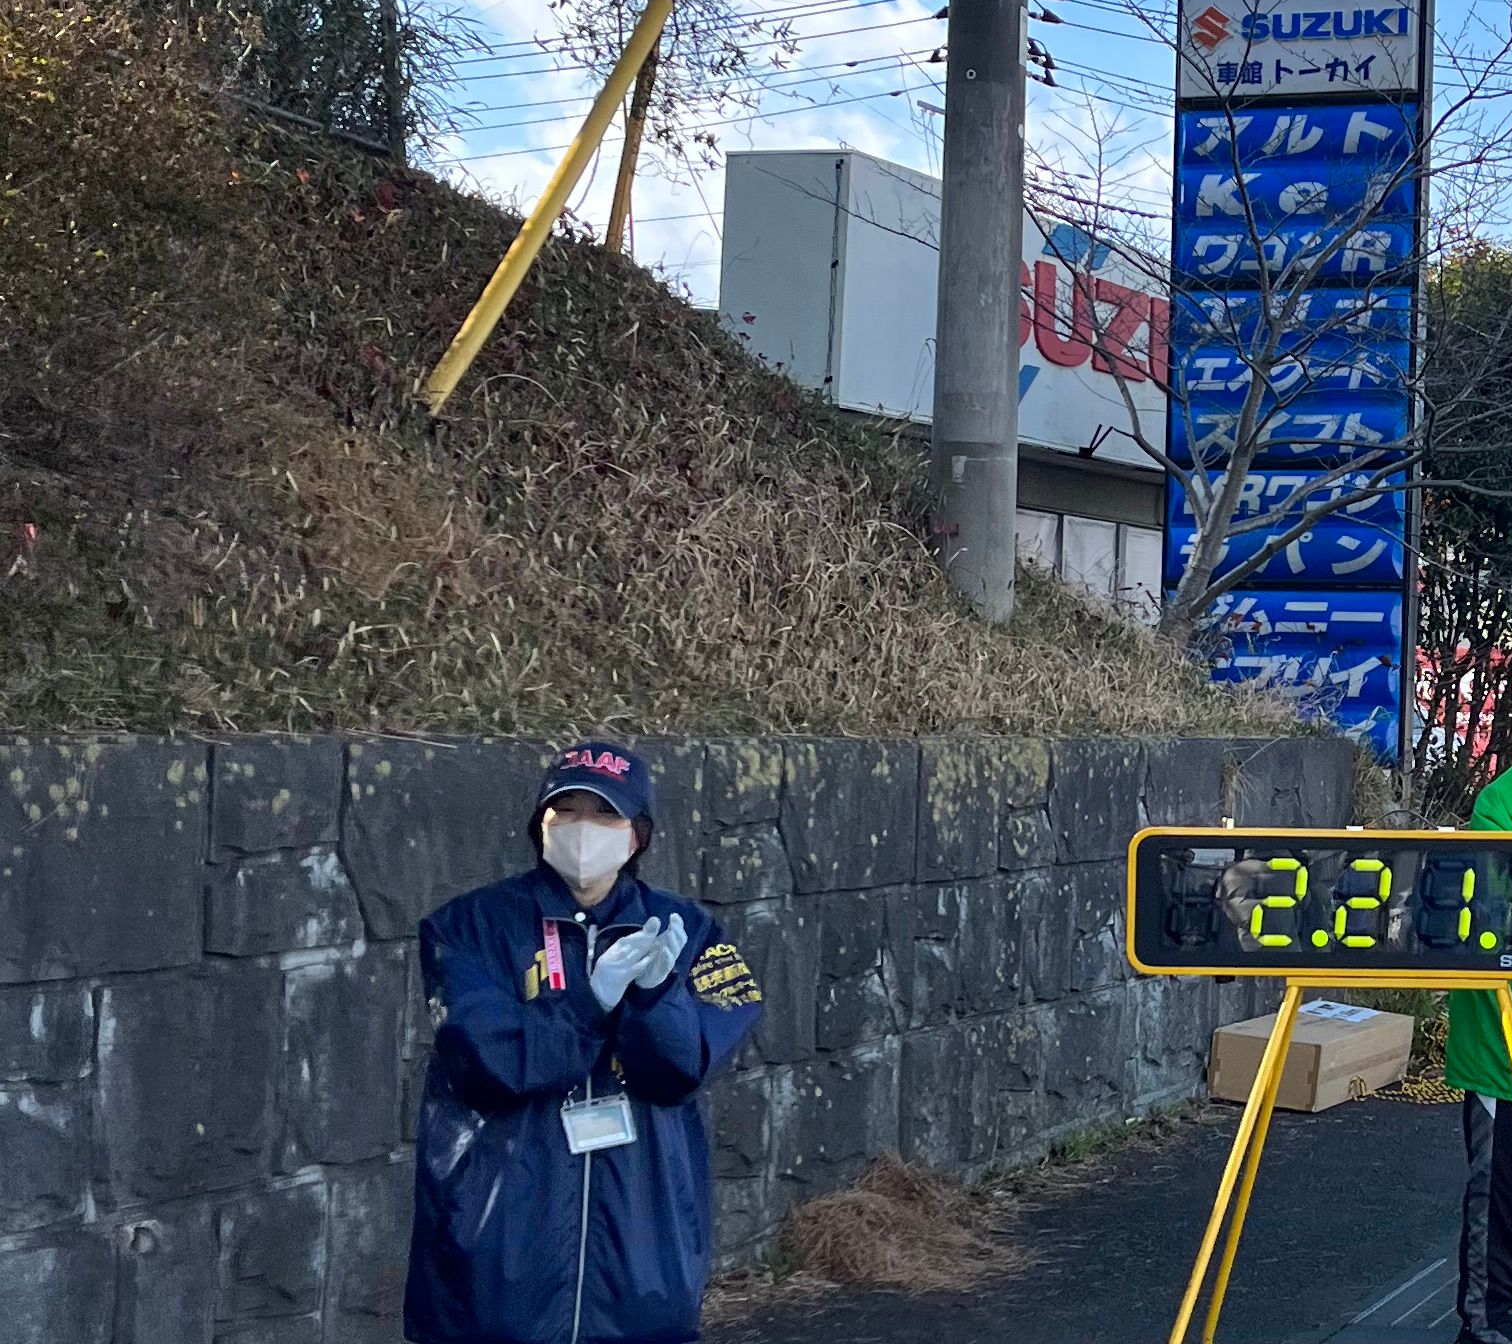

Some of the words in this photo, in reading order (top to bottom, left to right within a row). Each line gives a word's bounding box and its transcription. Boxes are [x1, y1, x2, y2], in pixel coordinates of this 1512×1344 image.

[1241, 6, 1409, 40] SUZUKI
[1192, 111, 1394, 156] アルト
